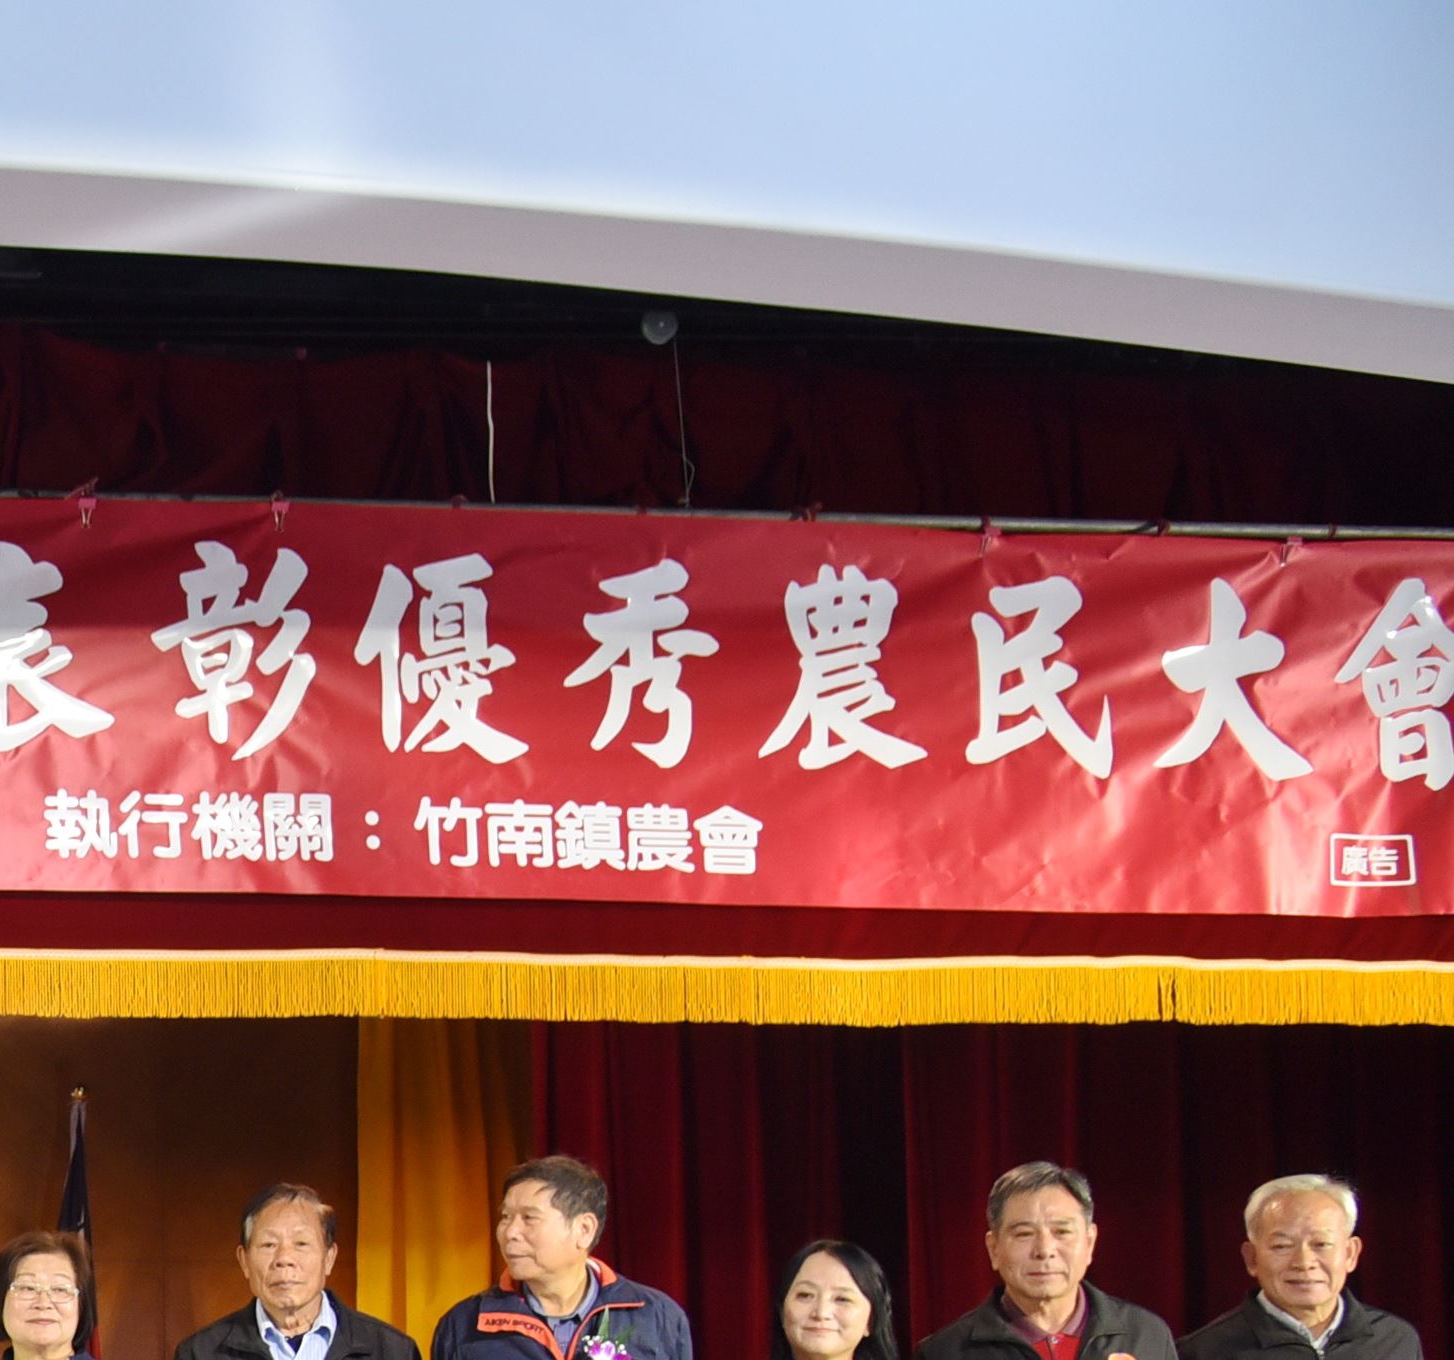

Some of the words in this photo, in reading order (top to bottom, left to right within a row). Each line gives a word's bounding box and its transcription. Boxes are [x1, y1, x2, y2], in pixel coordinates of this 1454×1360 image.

[44, 789, 764, 875] 執行機關：竹南鎮農會
[1341, 846, 1399, 876] 廣告
